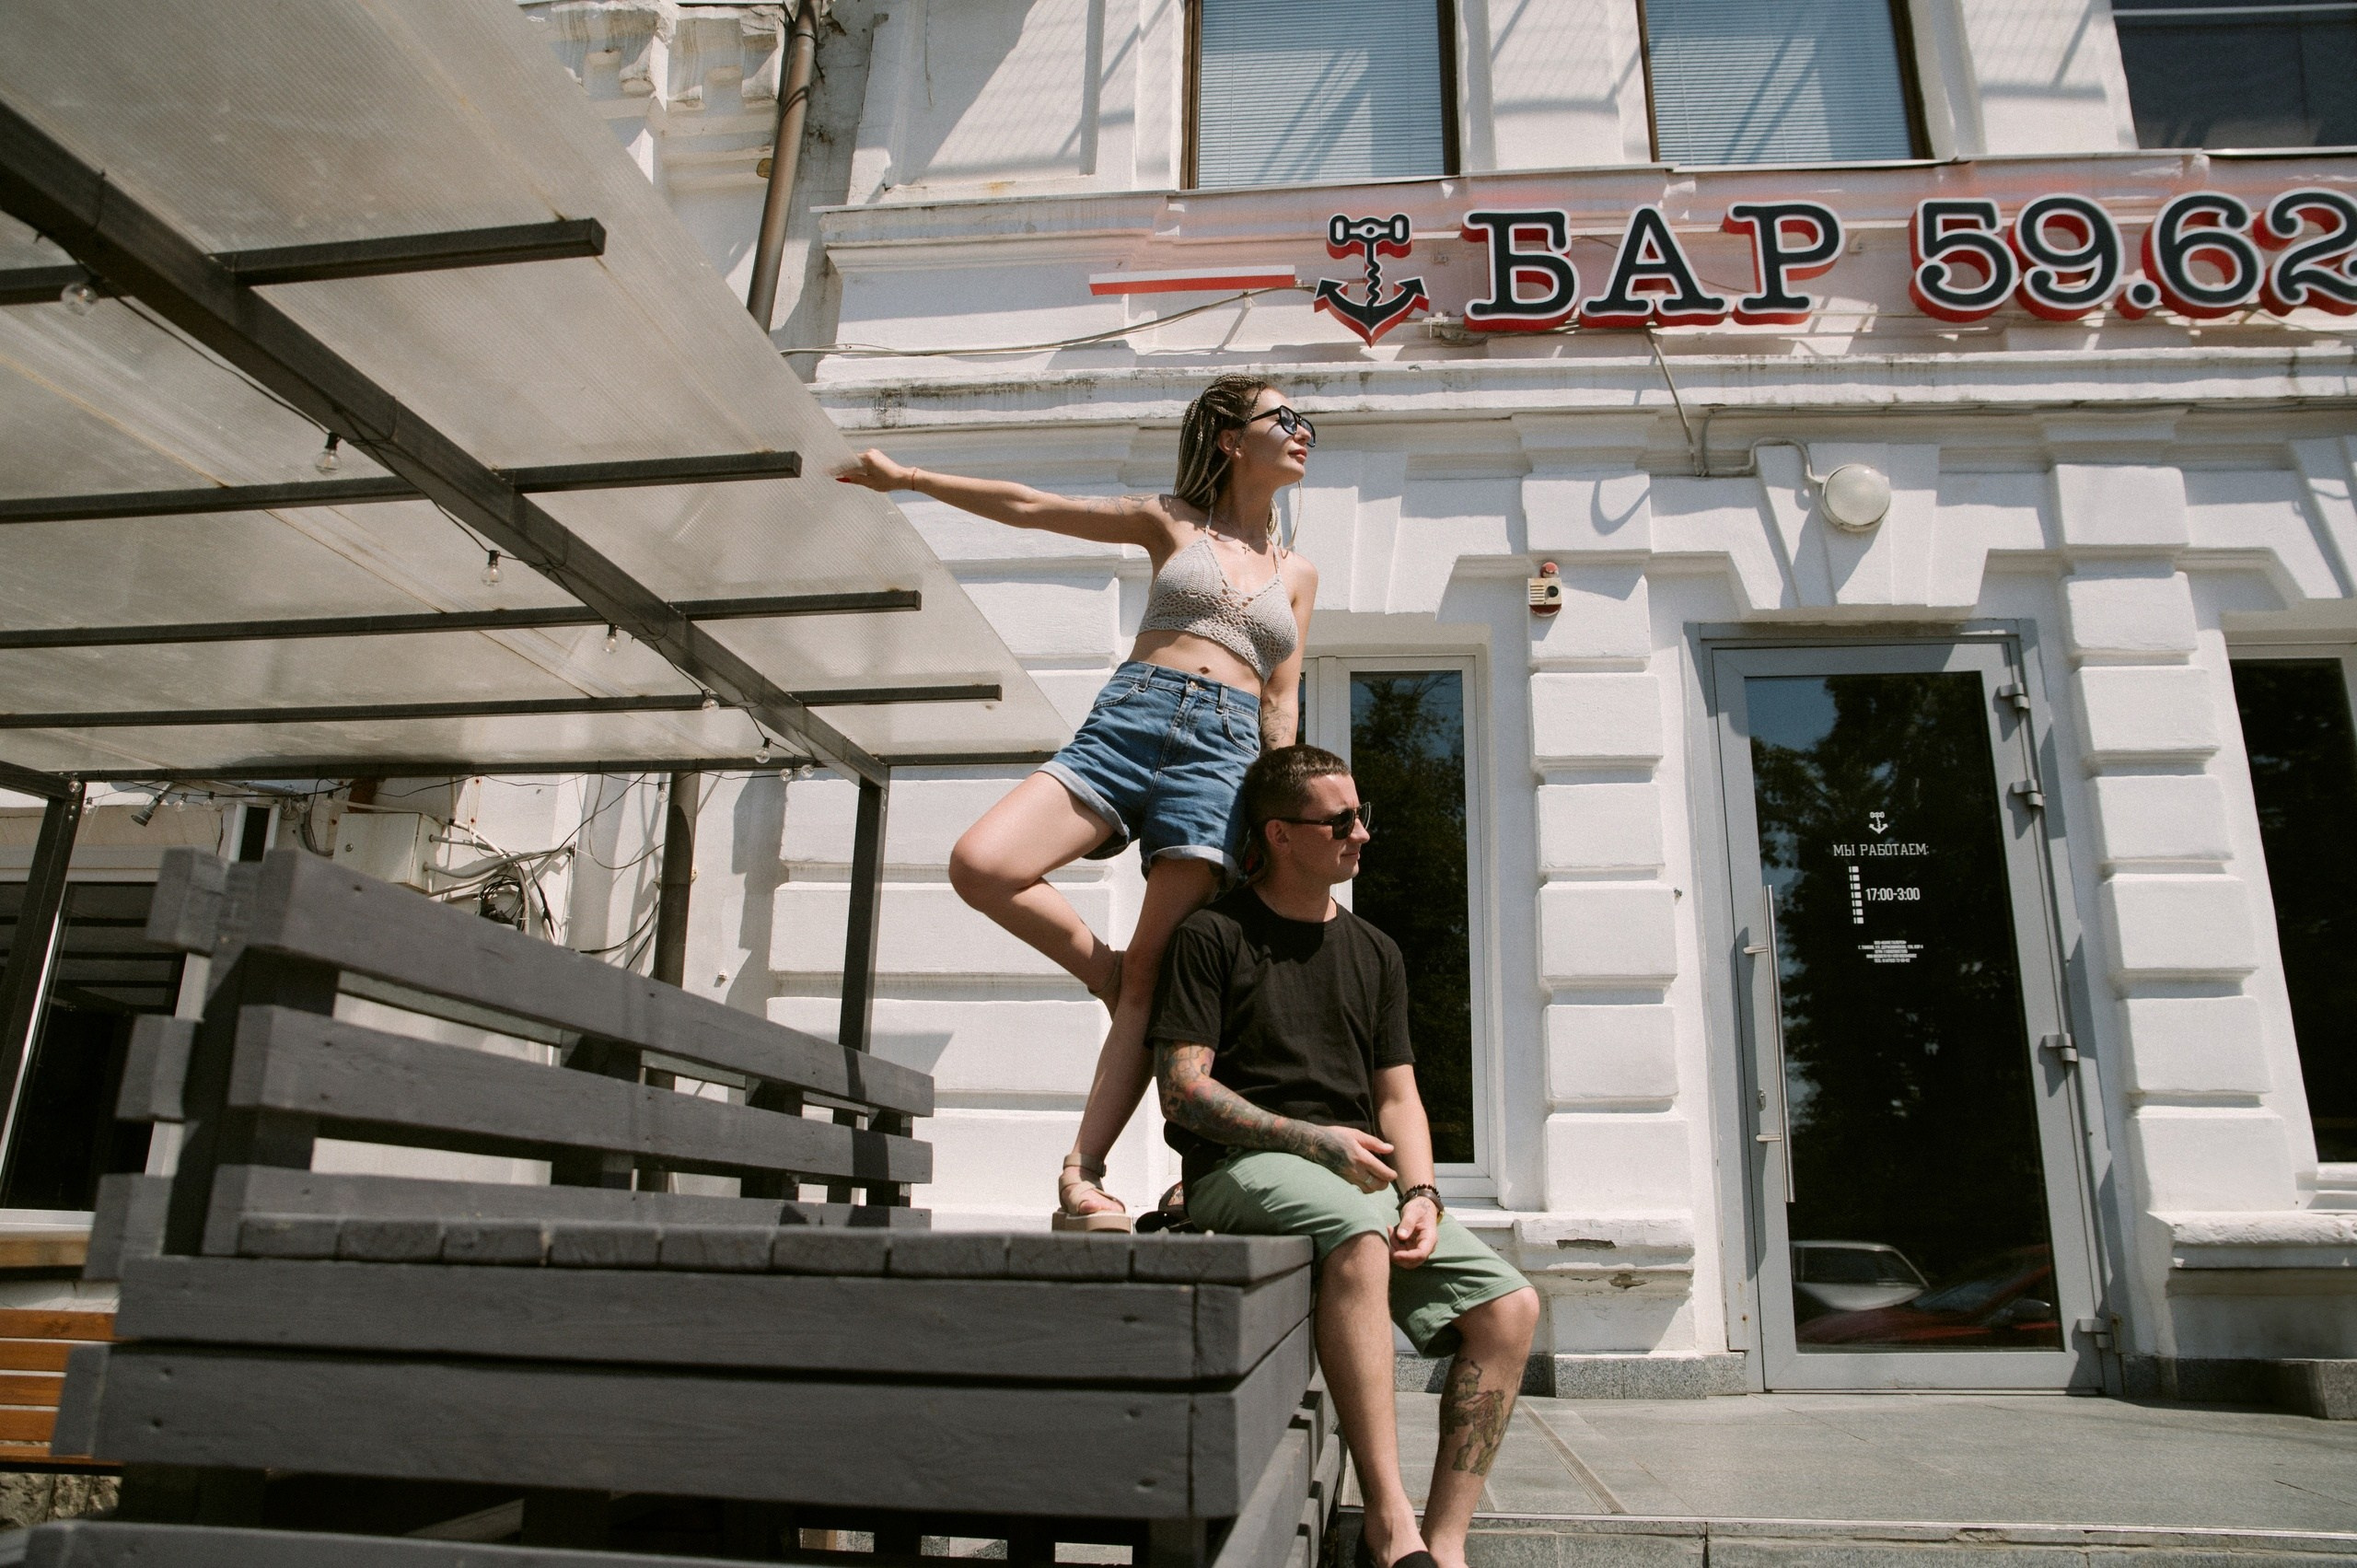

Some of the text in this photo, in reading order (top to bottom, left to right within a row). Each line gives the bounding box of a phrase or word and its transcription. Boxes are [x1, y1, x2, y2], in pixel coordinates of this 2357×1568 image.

[1461, 188, 2357, 331] БАР 59.62
[1833, 843, 1929, 856] МЫ РАБОТАЕМ:
[1865, 888, 1921, 900] 17:00-3:00
